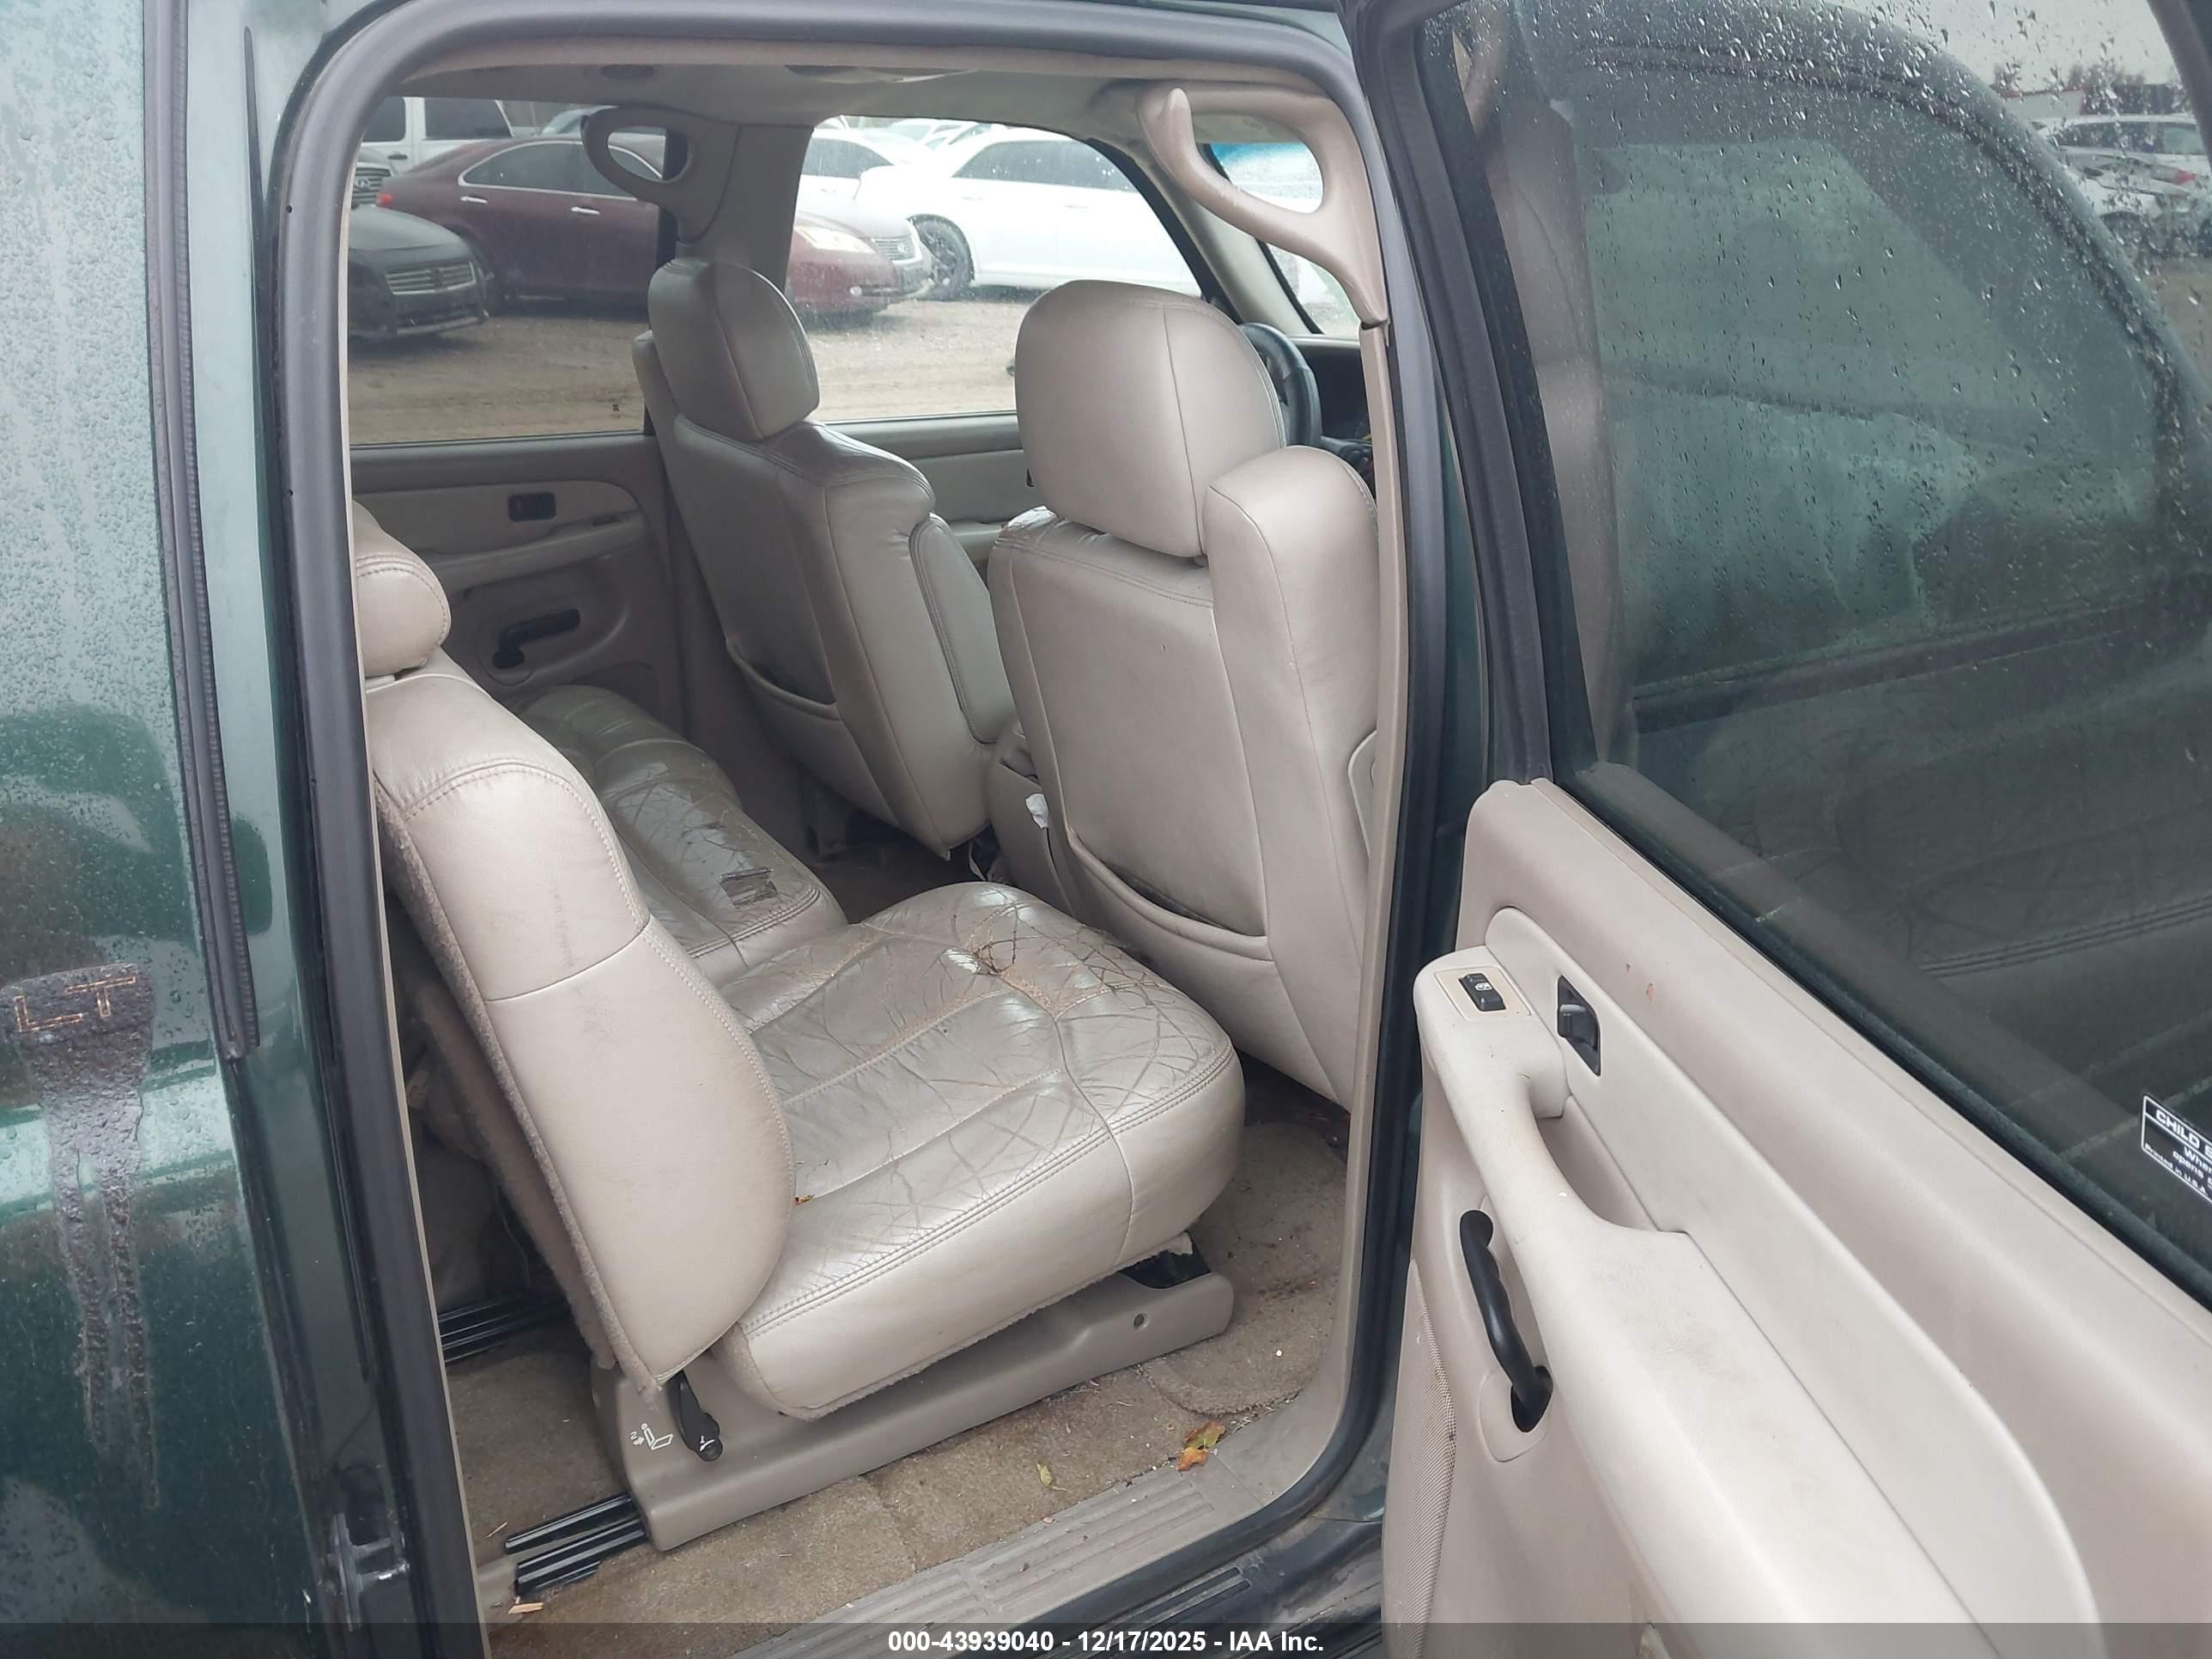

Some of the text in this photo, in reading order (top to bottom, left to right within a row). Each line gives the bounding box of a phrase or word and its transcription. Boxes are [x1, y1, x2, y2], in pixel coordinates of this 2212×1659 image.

[14, 975, 137, 1032] LT
[2155, 1109, 2200, 1149] CHILD
[2145, 1142, 2173, 1169] Printed
[2175, 1166, 2183, 1176] in
[2172, 1151, 2204, 1179] opens
